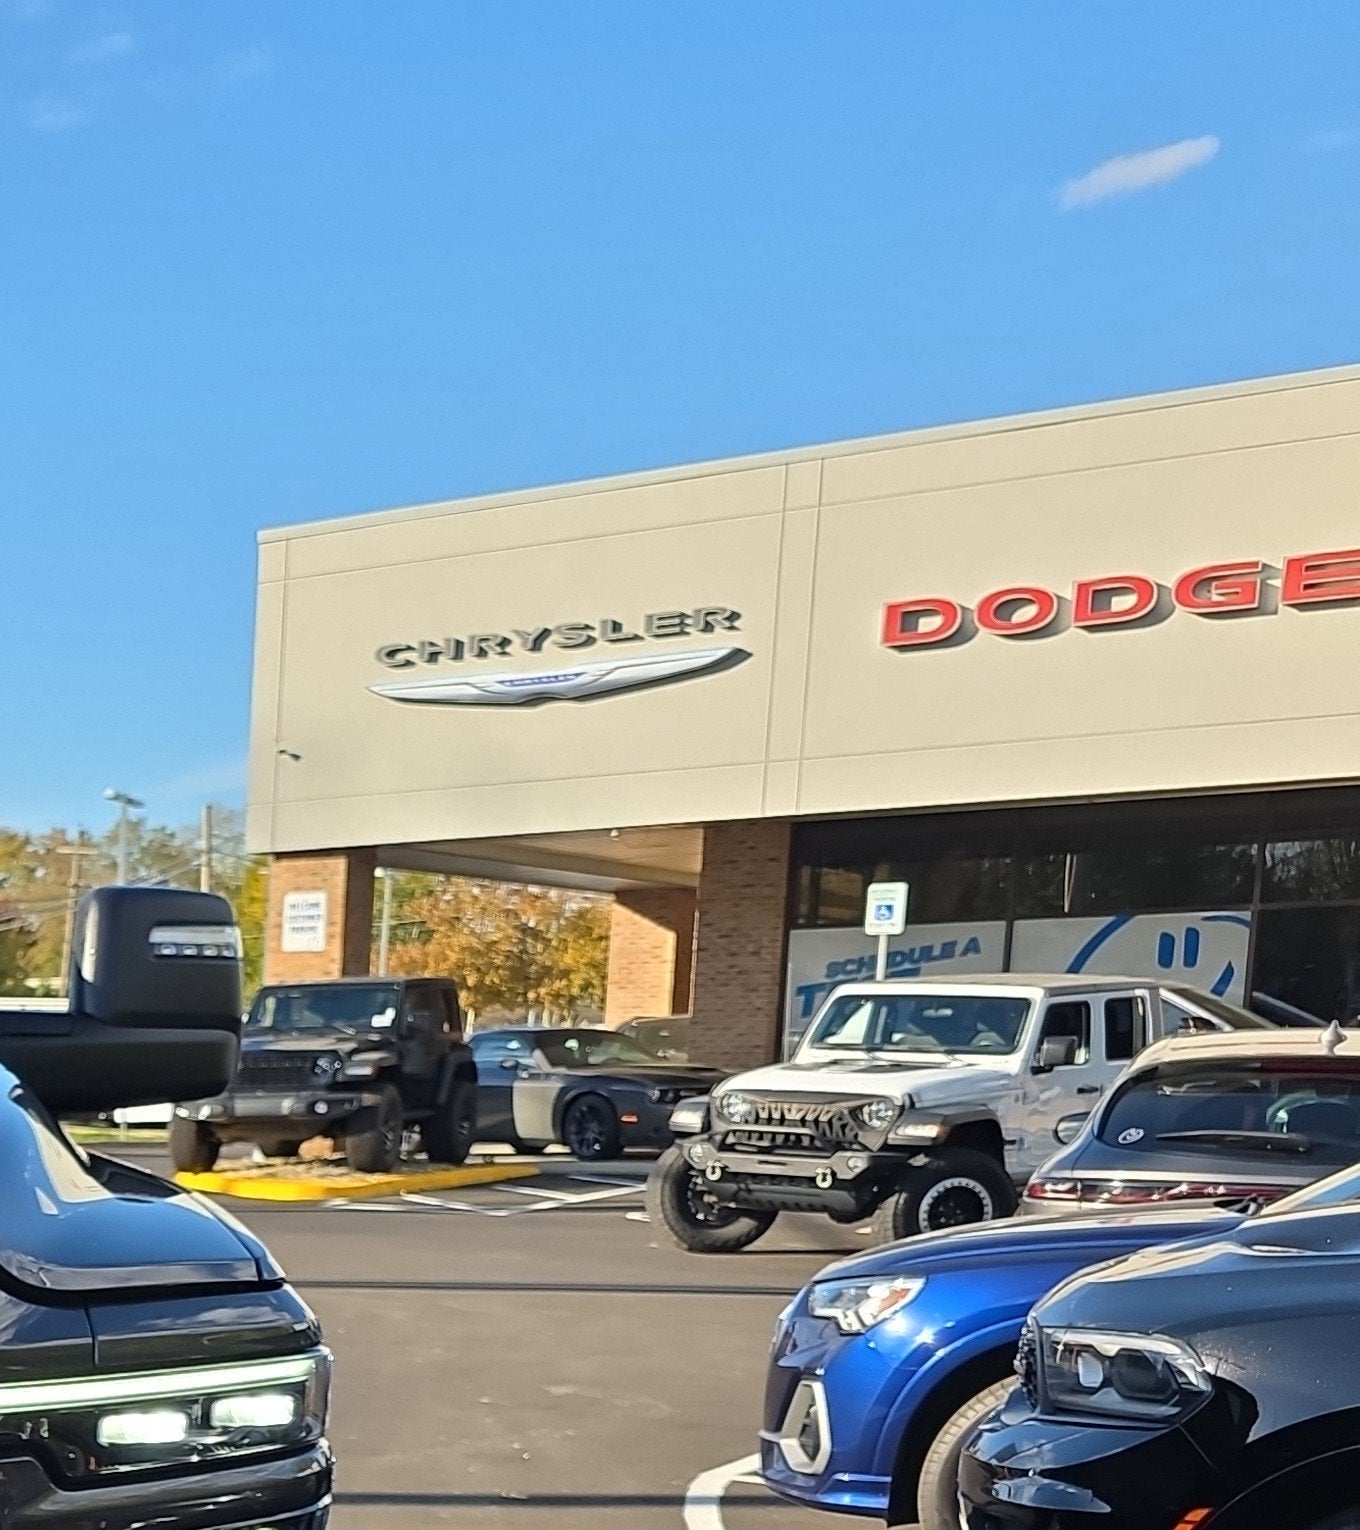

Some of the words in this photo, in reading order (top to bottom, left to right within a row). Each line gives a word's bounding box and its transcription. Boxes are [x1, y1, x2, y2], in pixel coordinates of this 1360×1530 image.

[880, 546, 1360, 649] DODGE
[377, 606, 742, 669] CHRYSLER
[825, 940, 958, 978] SCHDULE
[959, 936, 981, 957] A
